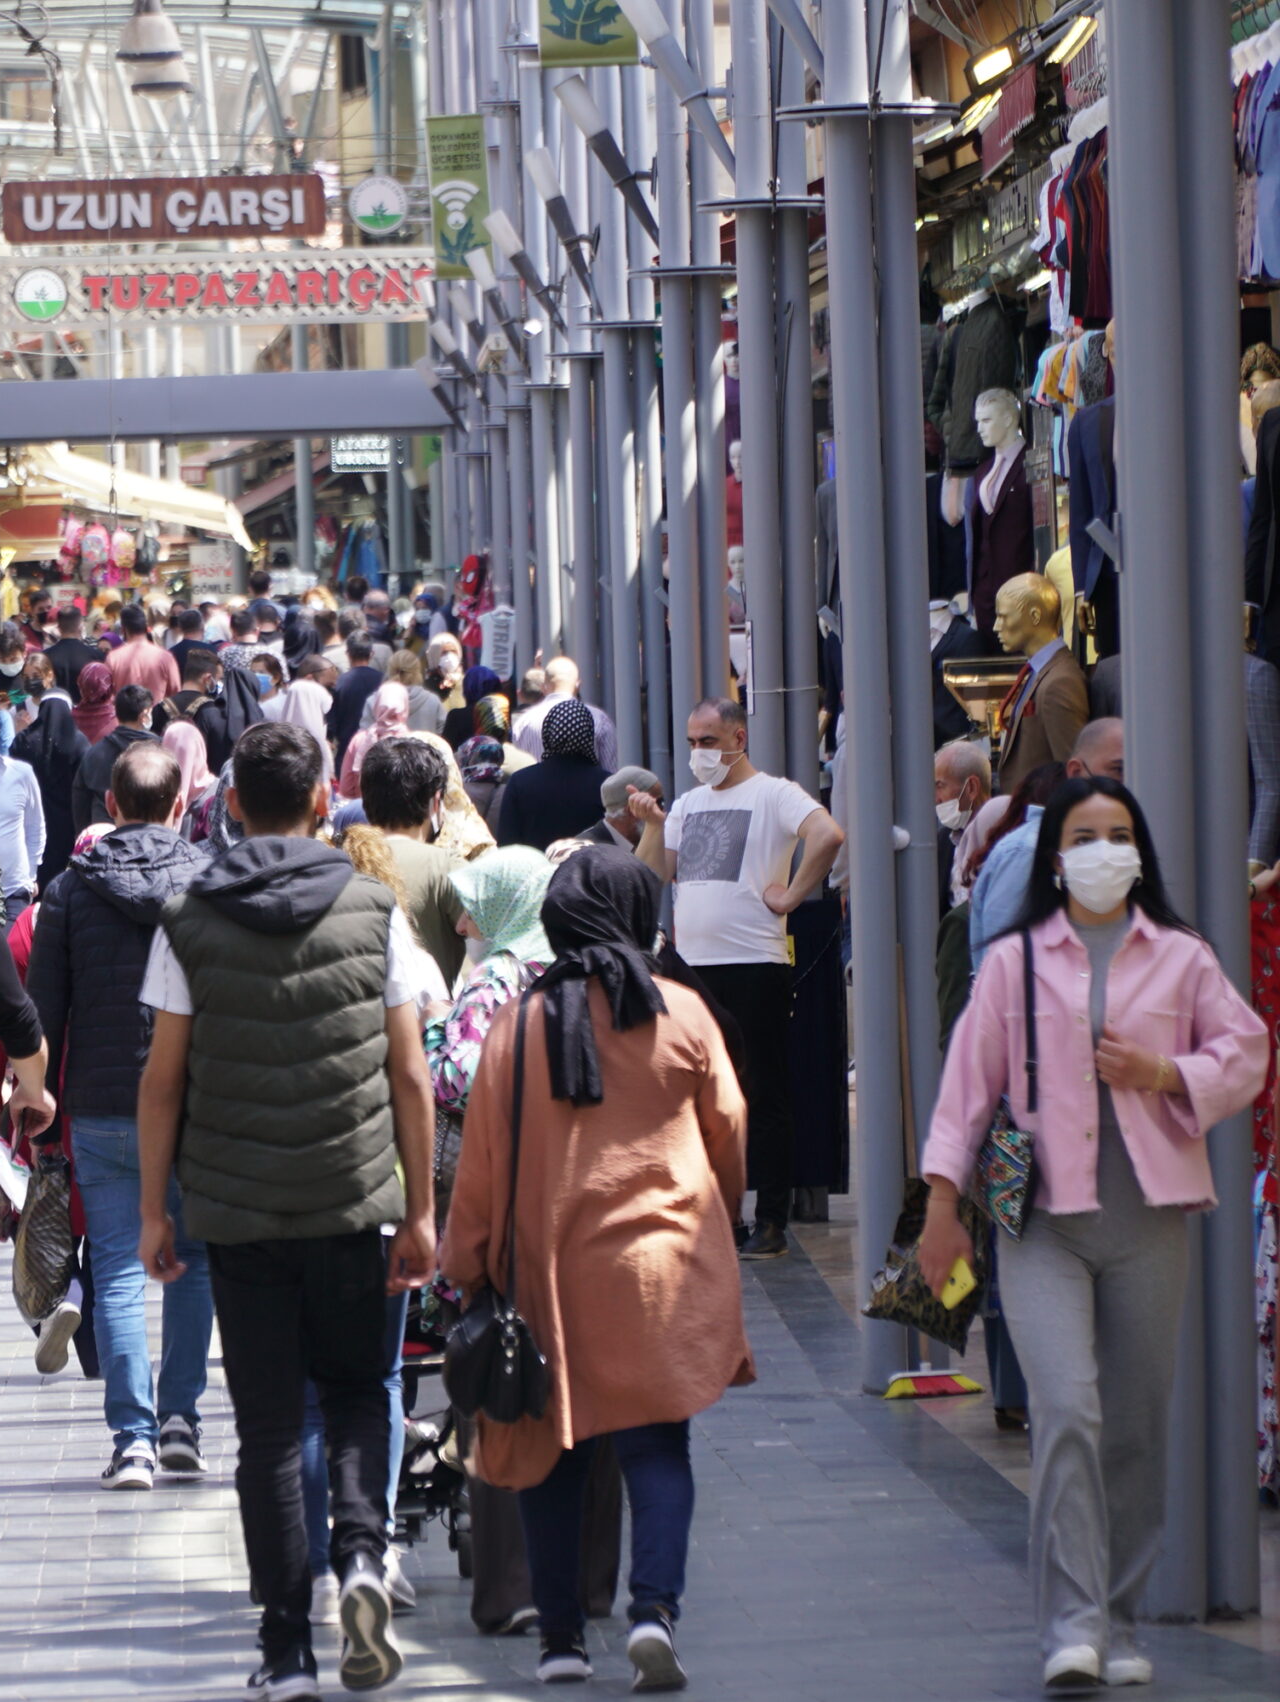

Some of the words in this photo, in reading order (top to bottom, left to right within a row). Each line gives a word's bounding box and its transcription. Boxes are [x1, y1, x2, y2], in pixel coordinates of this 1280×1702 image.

[22, 192, 153, 232] UZUN
[165, 187, 306, 234] ÇARŞI
[83, 269, 340, 311] TUZPAZARI
